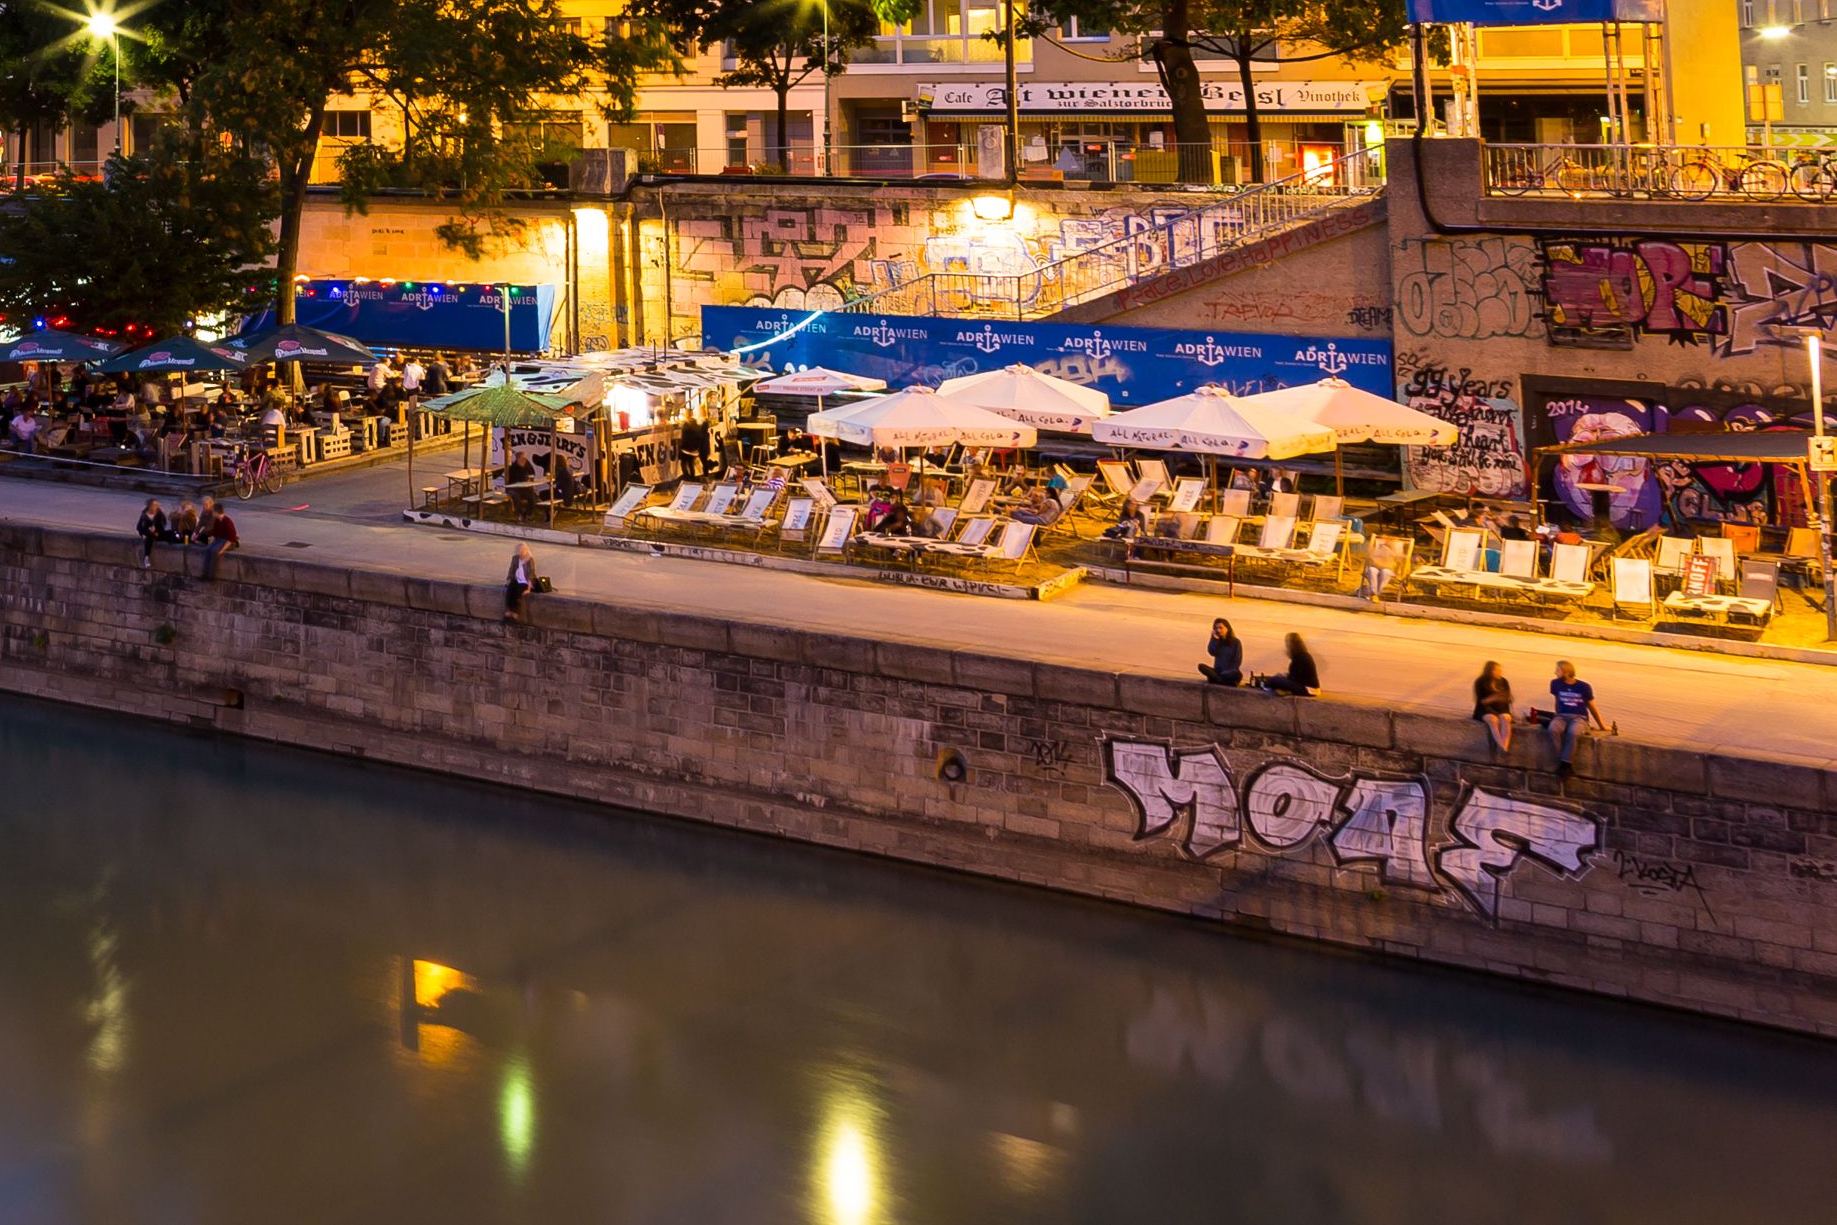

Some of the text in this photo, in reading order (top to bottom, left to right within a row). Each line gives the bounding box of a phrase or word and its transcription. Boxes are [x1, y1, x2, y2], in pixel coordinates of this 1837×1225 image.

[985, 87, 1034, 107] At
[1200, 83, 1285, 107] Besl
[1297, 89, 1361, 103] Vinothek
[1546, 399, 1589, 417] 2014
